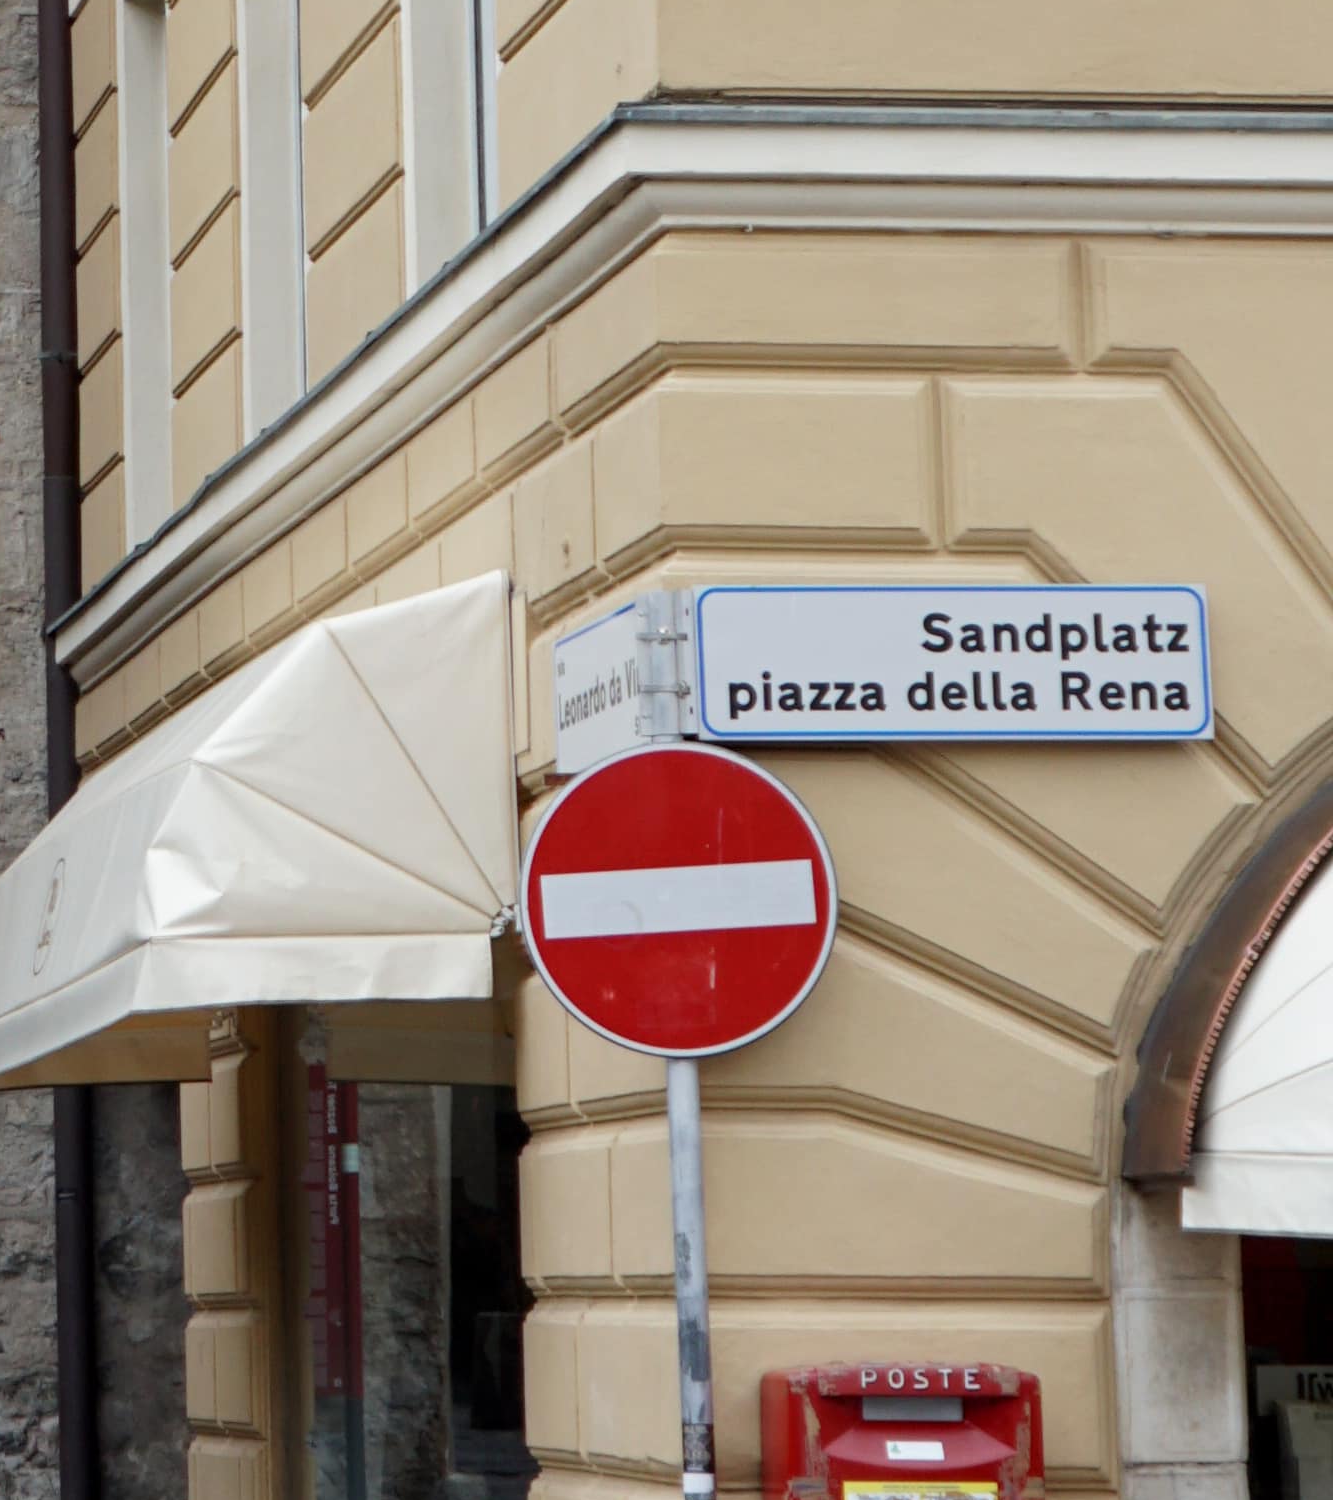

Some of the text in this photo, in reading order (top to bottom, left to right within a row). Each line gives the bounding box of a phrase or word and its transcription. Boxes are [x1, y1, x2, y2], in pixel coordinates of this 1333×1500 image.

[921, 612, 1190, 660] Sandplatz
[558, 673, 606, 731] Leonardo
[609, 667, 622, 707] da
[728, 671, 1190, 720] piazza della Rena
[861, 1368, 981, 1390] POSTE
